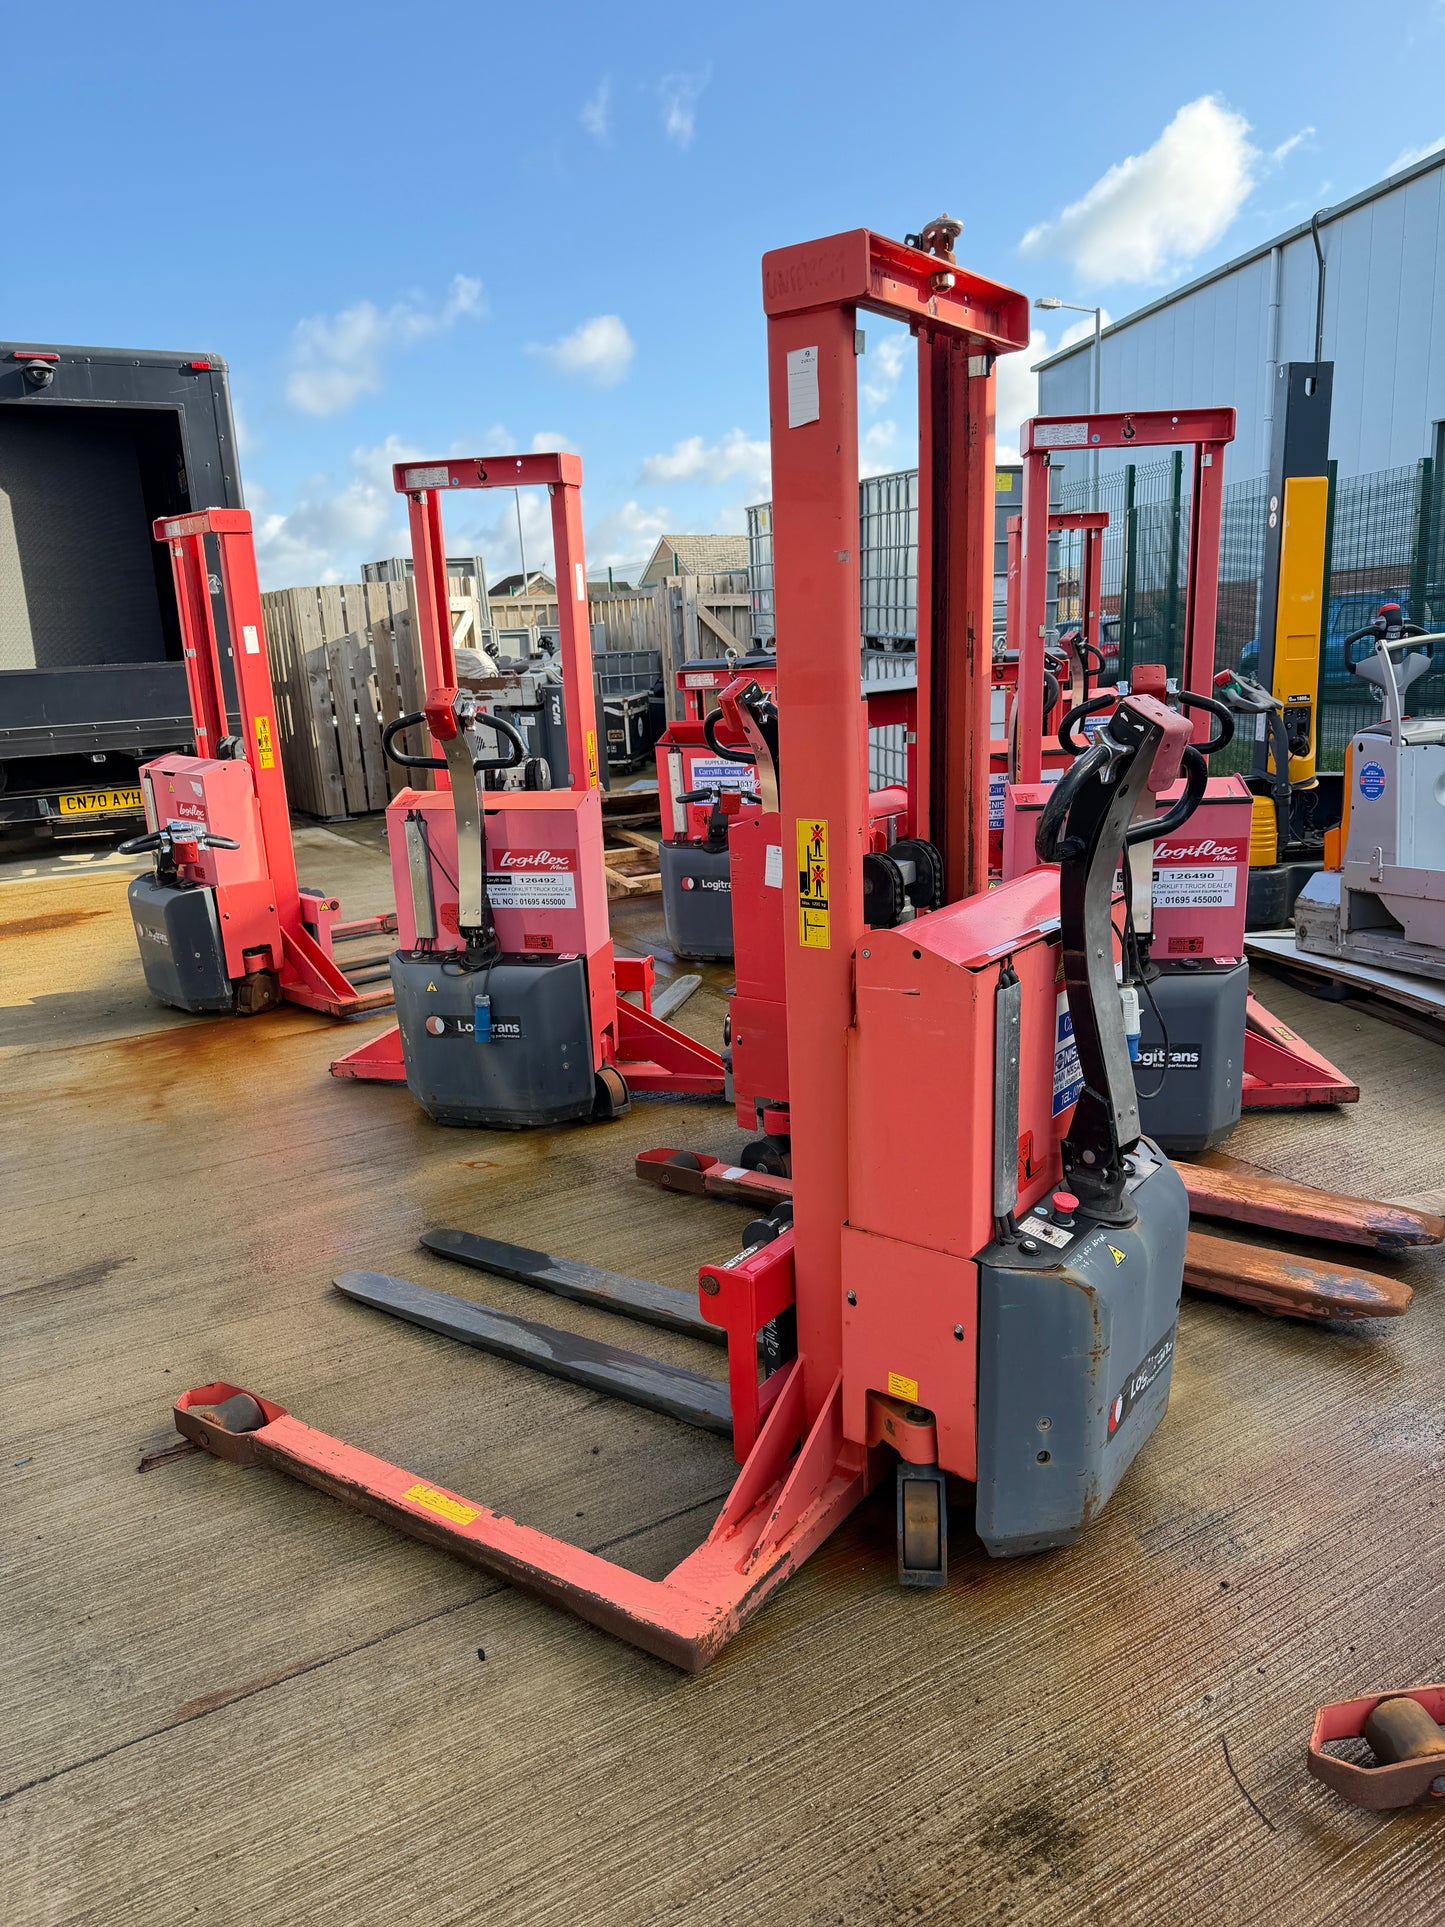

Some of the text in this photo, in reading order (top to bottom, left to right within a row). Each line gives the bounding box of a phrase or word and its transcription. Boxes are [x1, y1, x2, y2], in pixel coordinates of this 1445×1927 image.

[552, 695, 562, 726] TCM
[698, 768, 742, 776] Carrylift Group
[66, 792, 142, 810] CN70 AYH
[1153, 840, 1238, 860] Logiflex
[500, 850, 570, 868] Logiflex
[702, 880, 732, 890] Logitra
[1192, 896, 1222, 904] 455000
[458, 1020, 520, 1033] Lorans
